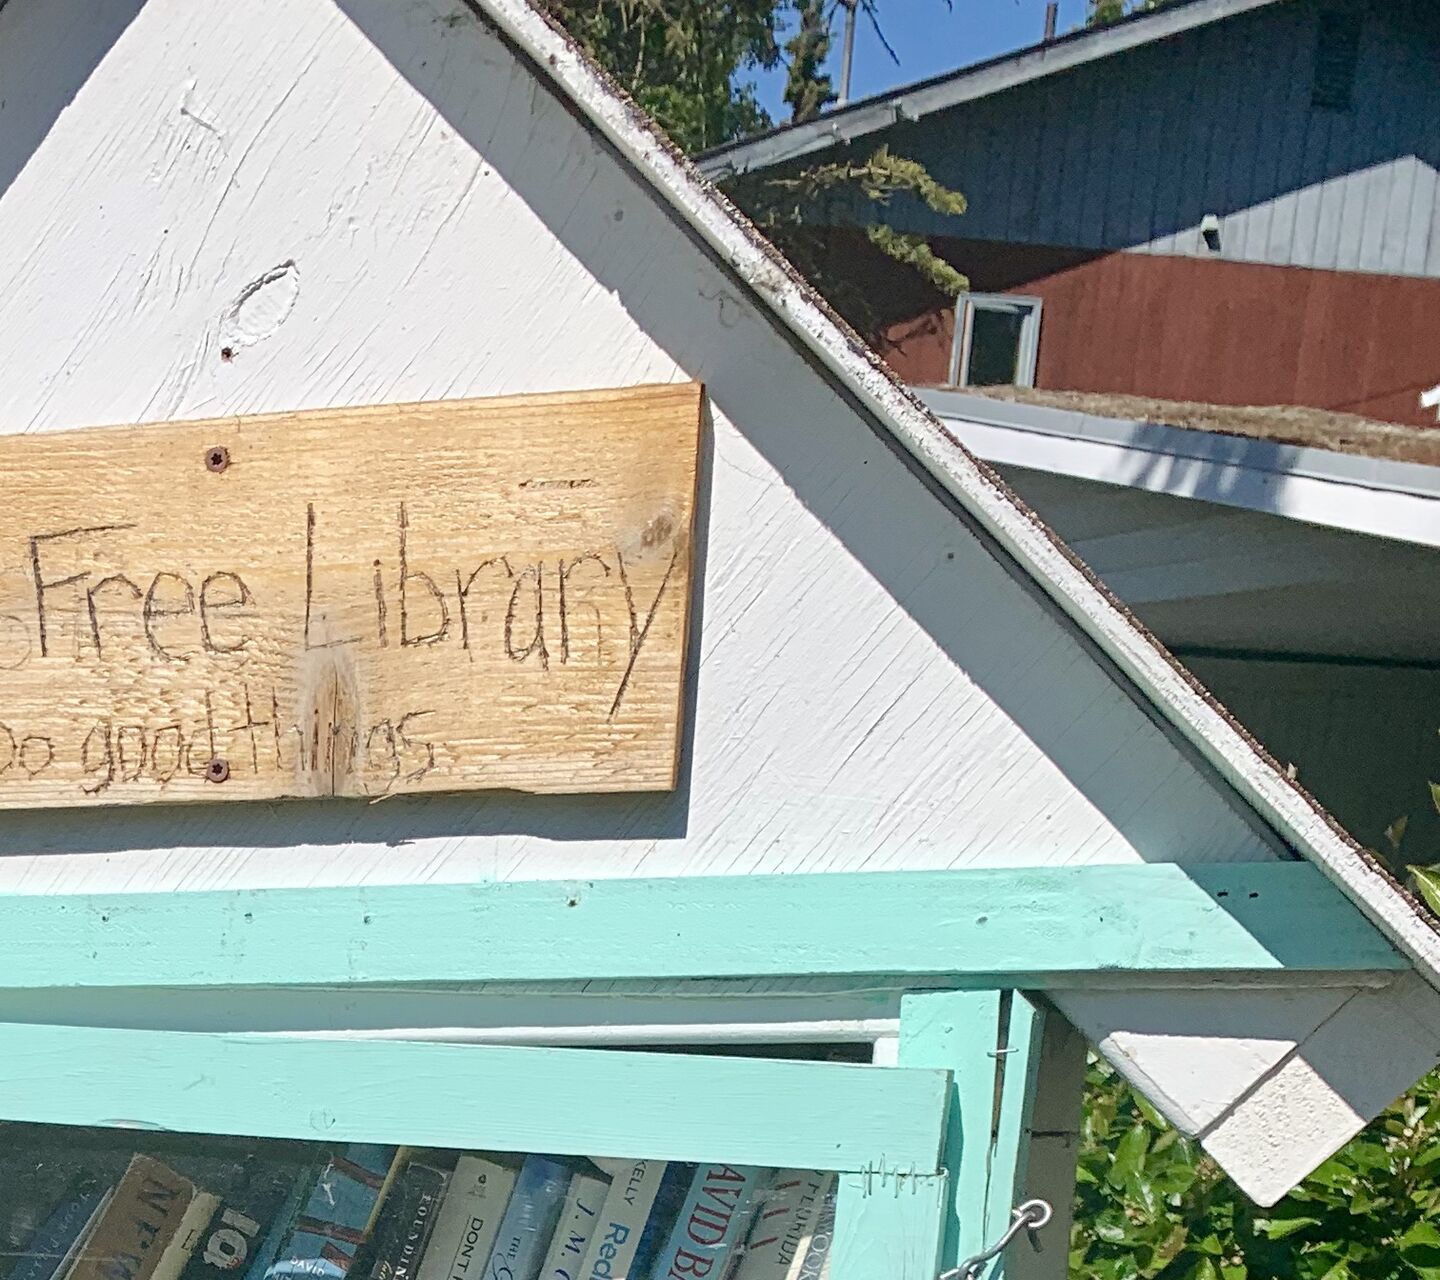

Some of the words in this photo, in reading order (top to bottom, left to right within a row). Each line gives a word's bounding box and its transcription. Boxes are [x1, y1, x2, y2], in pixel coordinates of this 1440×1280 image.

[30, 522, 252, 663] Free
[304, 500, 678, 724] Library
[79, 690, 224, 794] good
[574, 1198, 596, 1220] J.
[687, 1163, 747, 1247] AVID
[506, 1234, 522, 1261] THE
[559, 1229, 587, 1258] M.
[290, 1256, 326, 1278] DAVID
